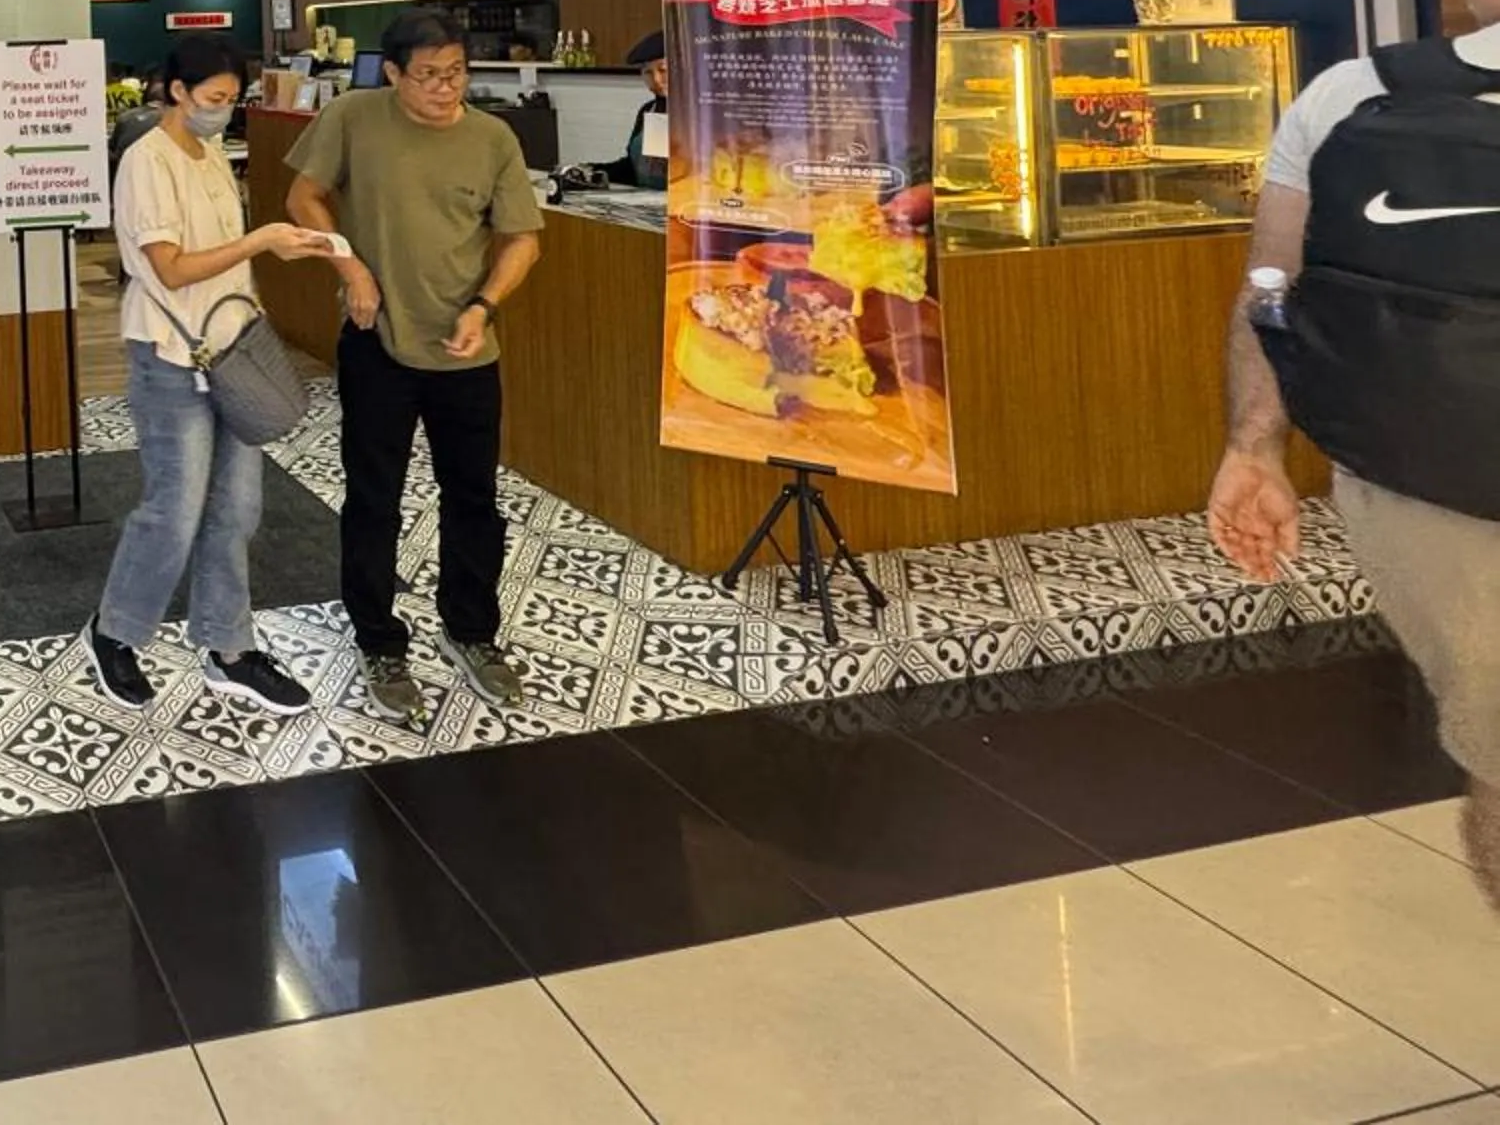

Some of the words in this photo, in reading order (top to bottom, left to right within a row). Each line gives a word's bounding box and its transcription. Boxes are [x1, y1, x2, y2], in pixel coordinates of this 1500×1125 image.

[2, 80, 40, 91] Please
[43, 80, 67, 90] wait
[70, 79, 87, 90] for
[21, 95, 45, 104] seat
[47, 94, 79, 104] ticket
[3, 110, 14, 120] to
[18, 108, 32, 119] be
[36, 106, 87, 120] assigned
[20, 165, 76, 176] Takeaway
[5, 180, 39, 191] direct
[41, 177, 89, 191] proceed
